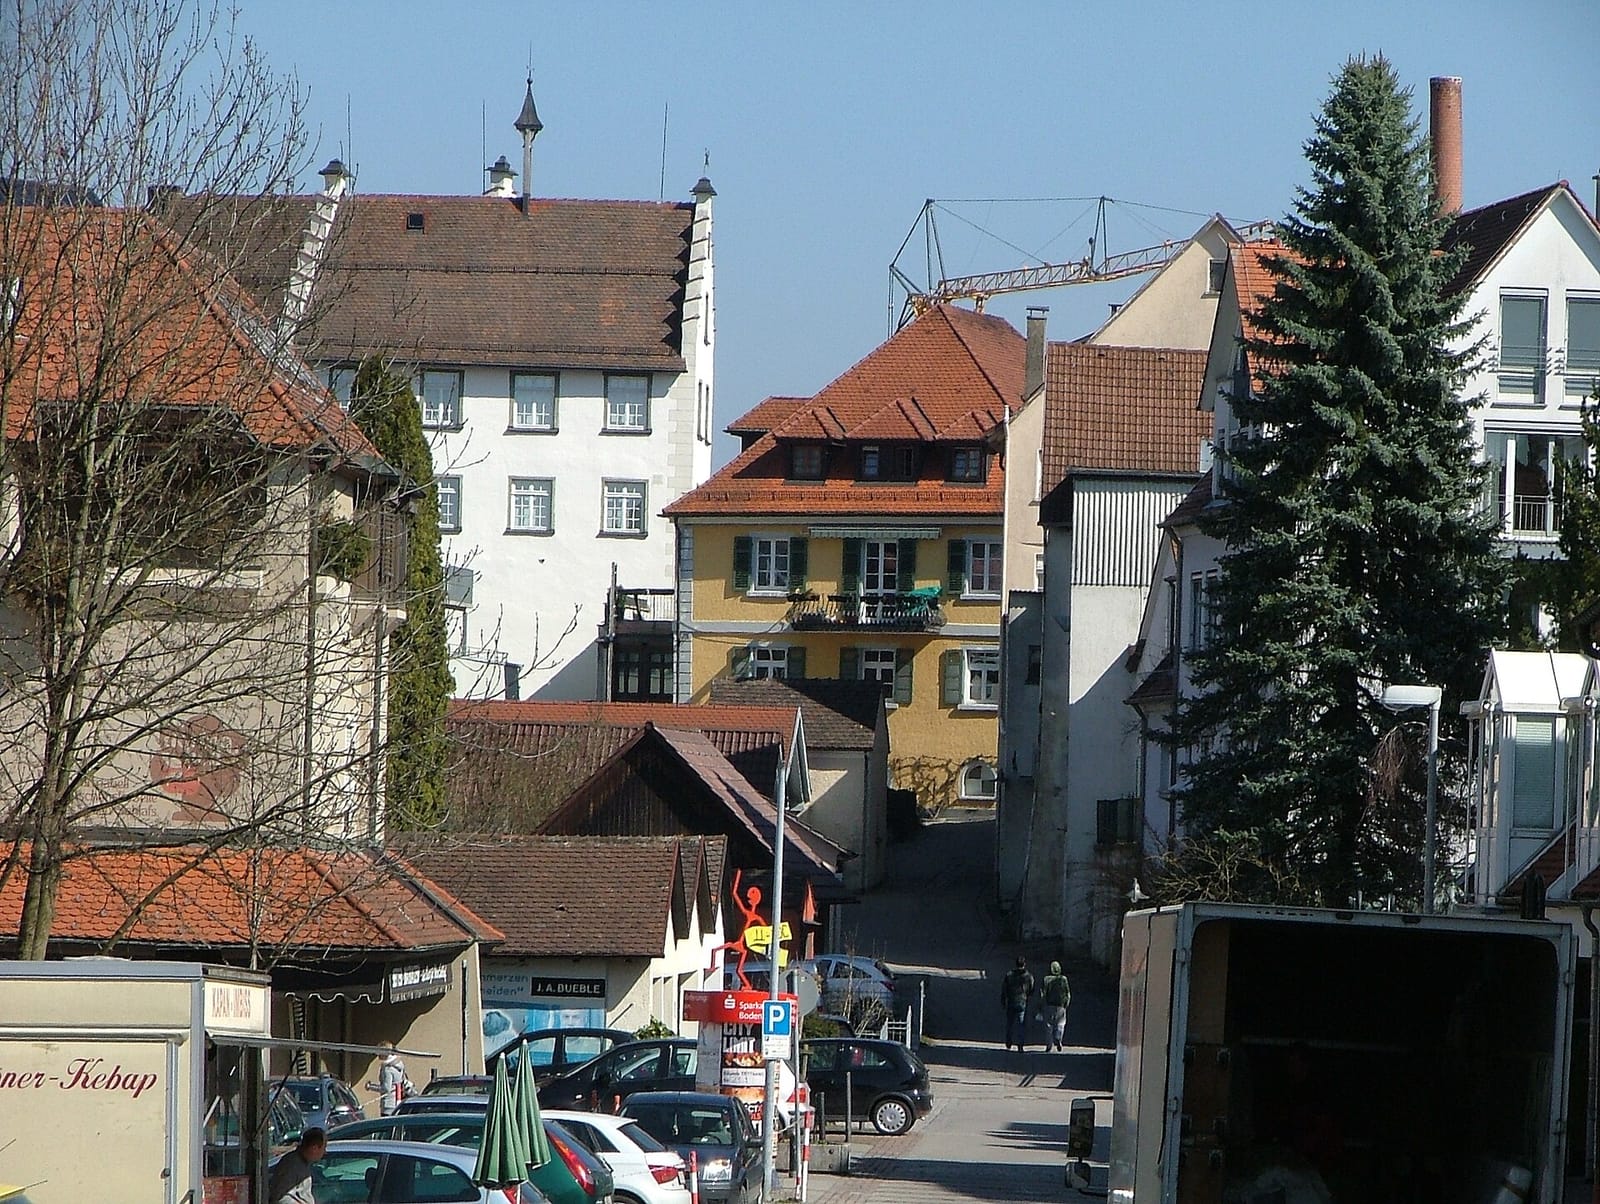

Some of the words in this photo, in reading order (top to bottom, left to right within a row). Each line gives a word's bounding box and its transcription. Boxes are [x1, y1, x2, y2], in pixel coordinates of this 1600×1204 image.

[738, 1002, 763, 1010] Sparka
[769, 1005, 786, 1033] P
[723, 1023, 754, 1036] CITY
[722, 1036, 756, 1053] LIMIT
[0, 1057, 158, 1099] ner-Kebap
